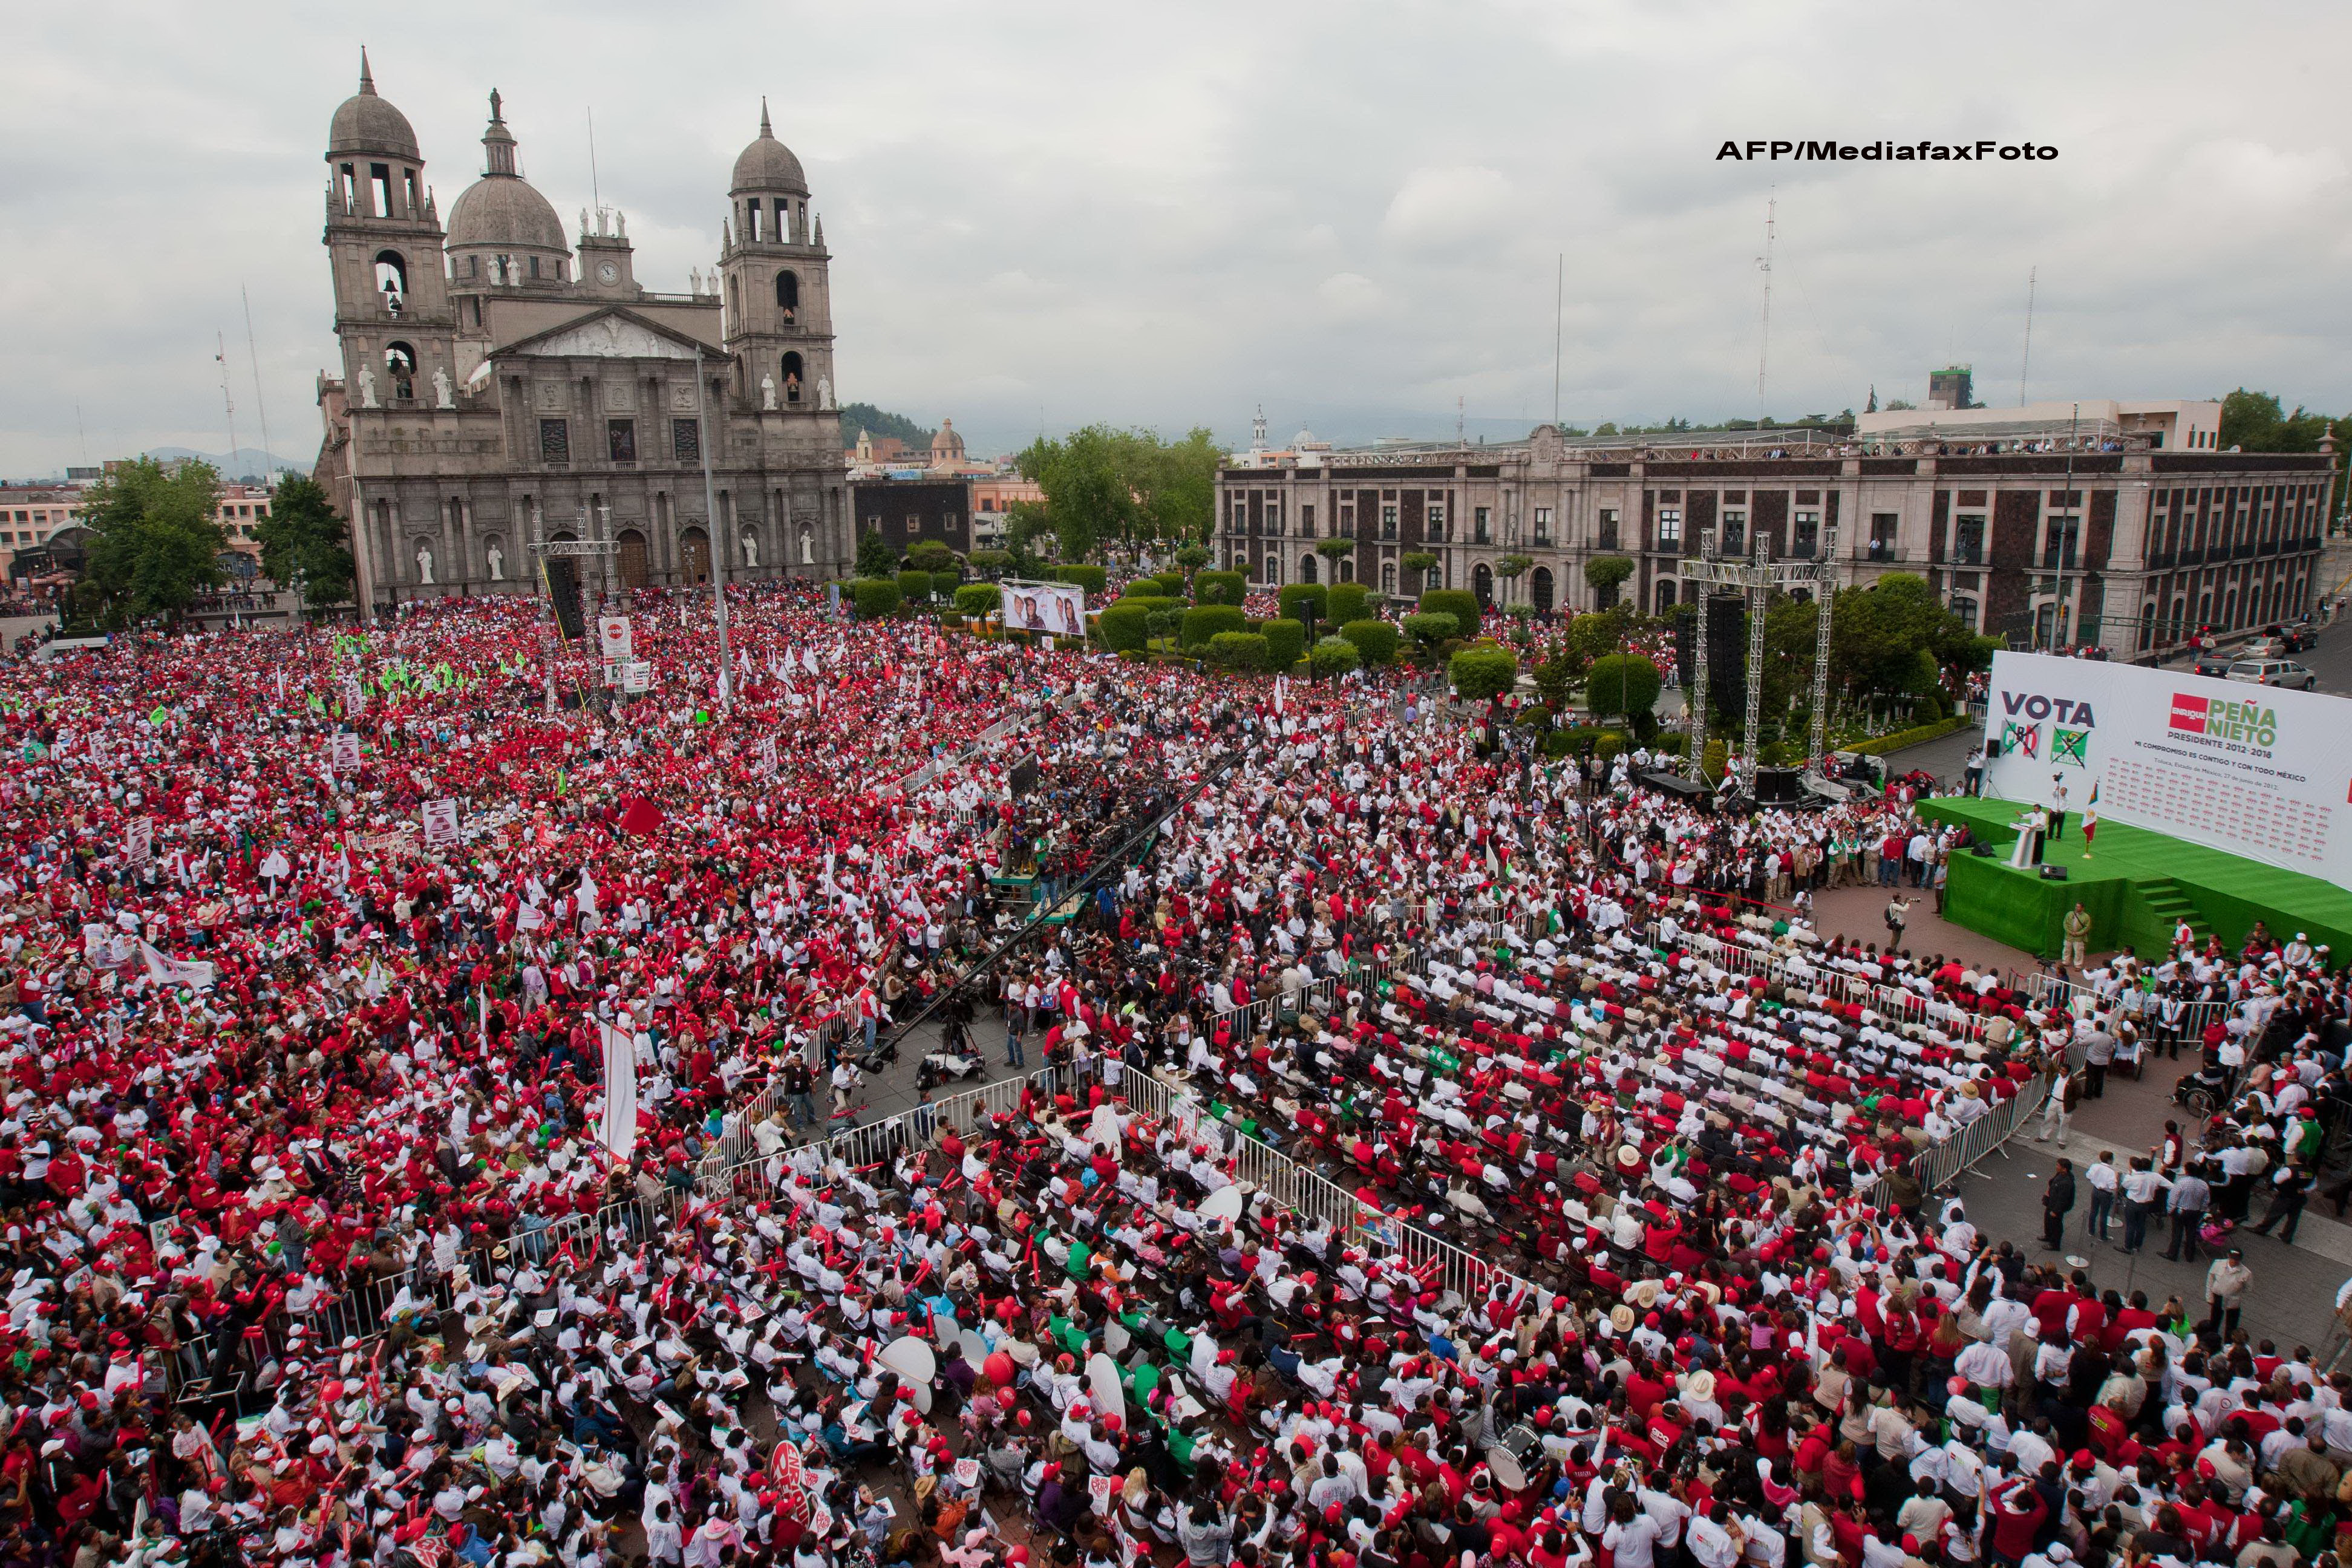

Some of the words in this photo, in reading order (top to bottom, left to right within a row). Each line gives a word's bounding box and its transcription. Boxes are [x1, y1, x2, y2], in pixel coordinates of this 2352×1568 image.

[2001, 691, 2095, 728] VOTA
[2172, 707, 2206, 720] ENRIQUE
[2209, 699, 2277, 729] PEÑA
[2005, 726, 2034, 750] PRI
[2167, 731, 2223, 748] PRESIDENTE
[2206, 719, 2276, 746] NIETO
[2143, 742, 2187, 756] COMPROMISO
[2198, 754, 2229, 766] CONTIGO
[2255, 766, 2275, 776] TODO
[2276, 771, 2306, 782] MÉXICO
[2174, 762, 2192, 771] Estado
